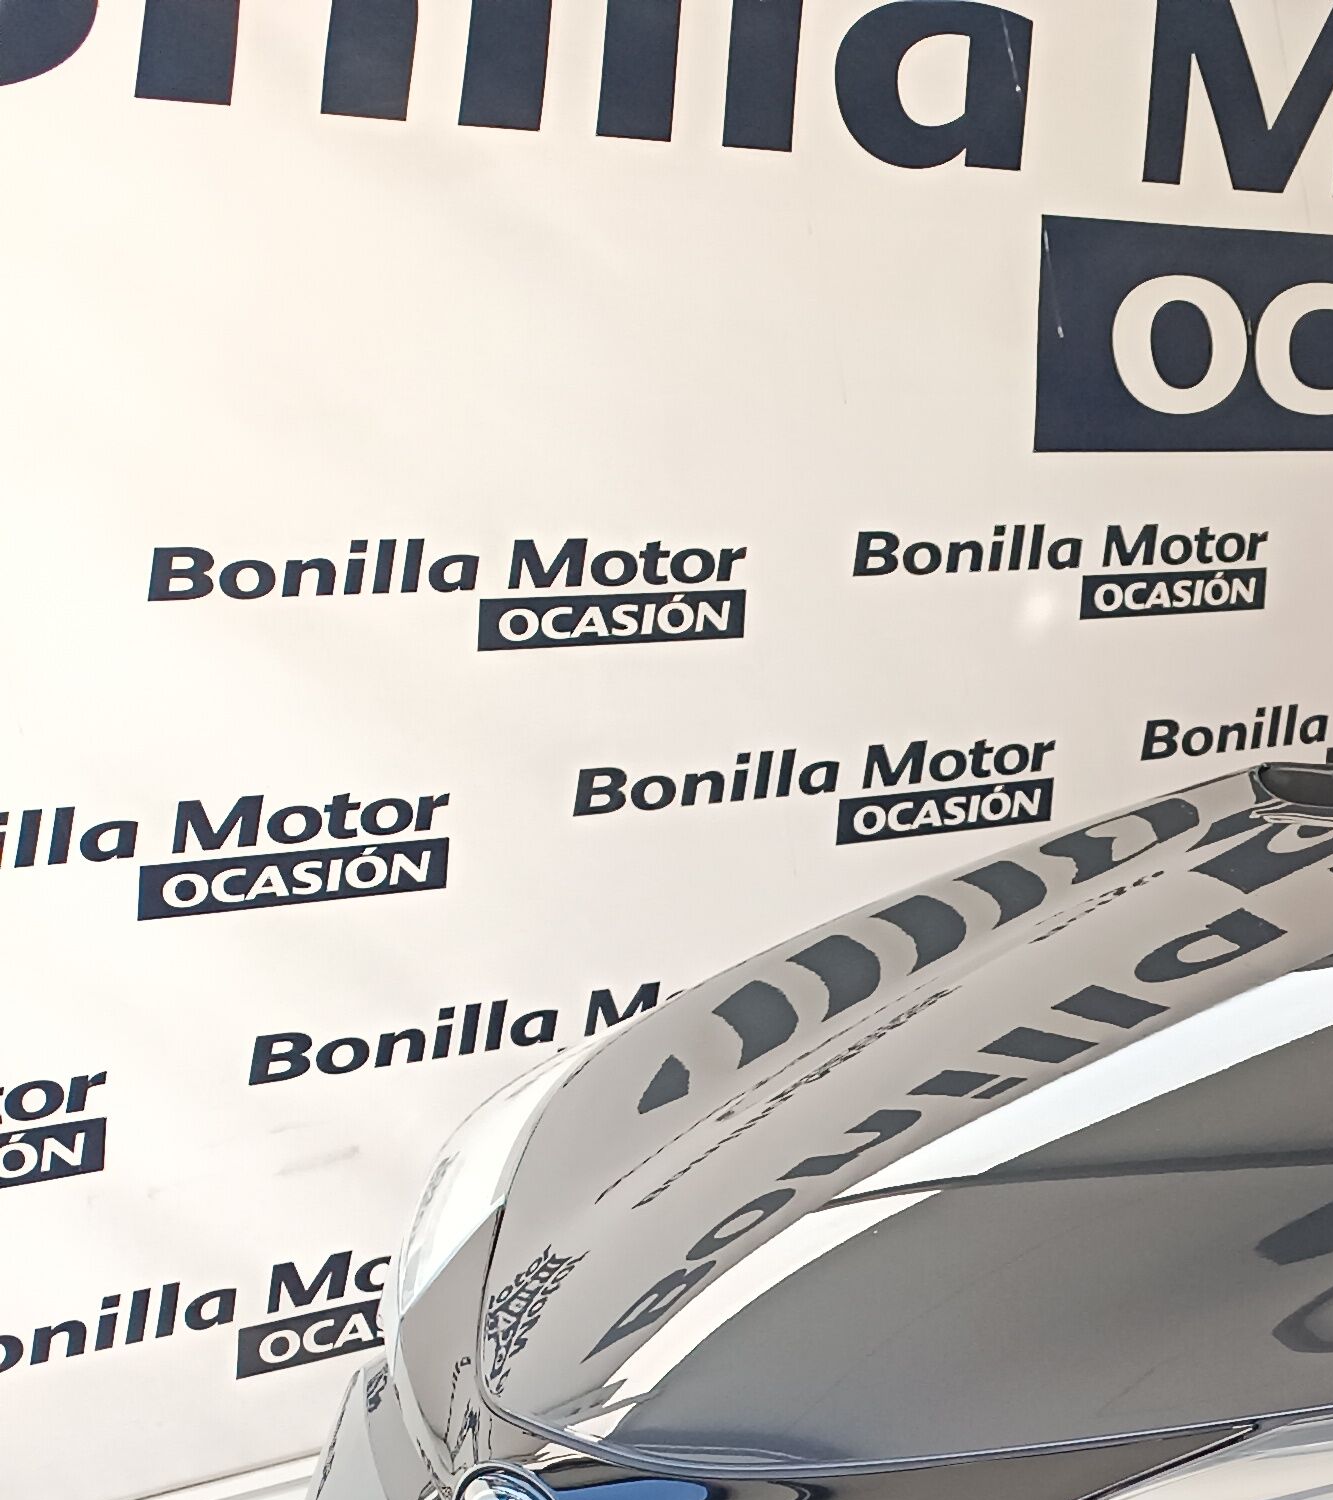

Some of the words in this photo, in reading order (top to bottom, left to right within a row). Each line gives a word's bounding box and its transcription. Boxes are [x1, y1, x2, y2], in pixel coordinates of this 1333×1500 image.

[148, 538, 480, 601] Bonilla
[508, 538, 747, 590] Motor
[852, 524, 1083, 578] Bonilla
[1101, 523, 1268, 567] Motor
[497, 594, 732, 643] OCASIÓN
[1092, 572, 1256, 613] OCASIÓN
[1140, 703, 1329, 761] Bonilla
[573, 748, 840, 817] Bonilla
[862, 739, 1056, 789] Motor
[172, 793, 450, 854] Motor
[853, 786, 1042, 836] OCASIÓN
[162, 846, 431, 908] OCASIÓN
[248, 998, 558, 1086] Bonilla
[0, 1070, 107, 1123] or
